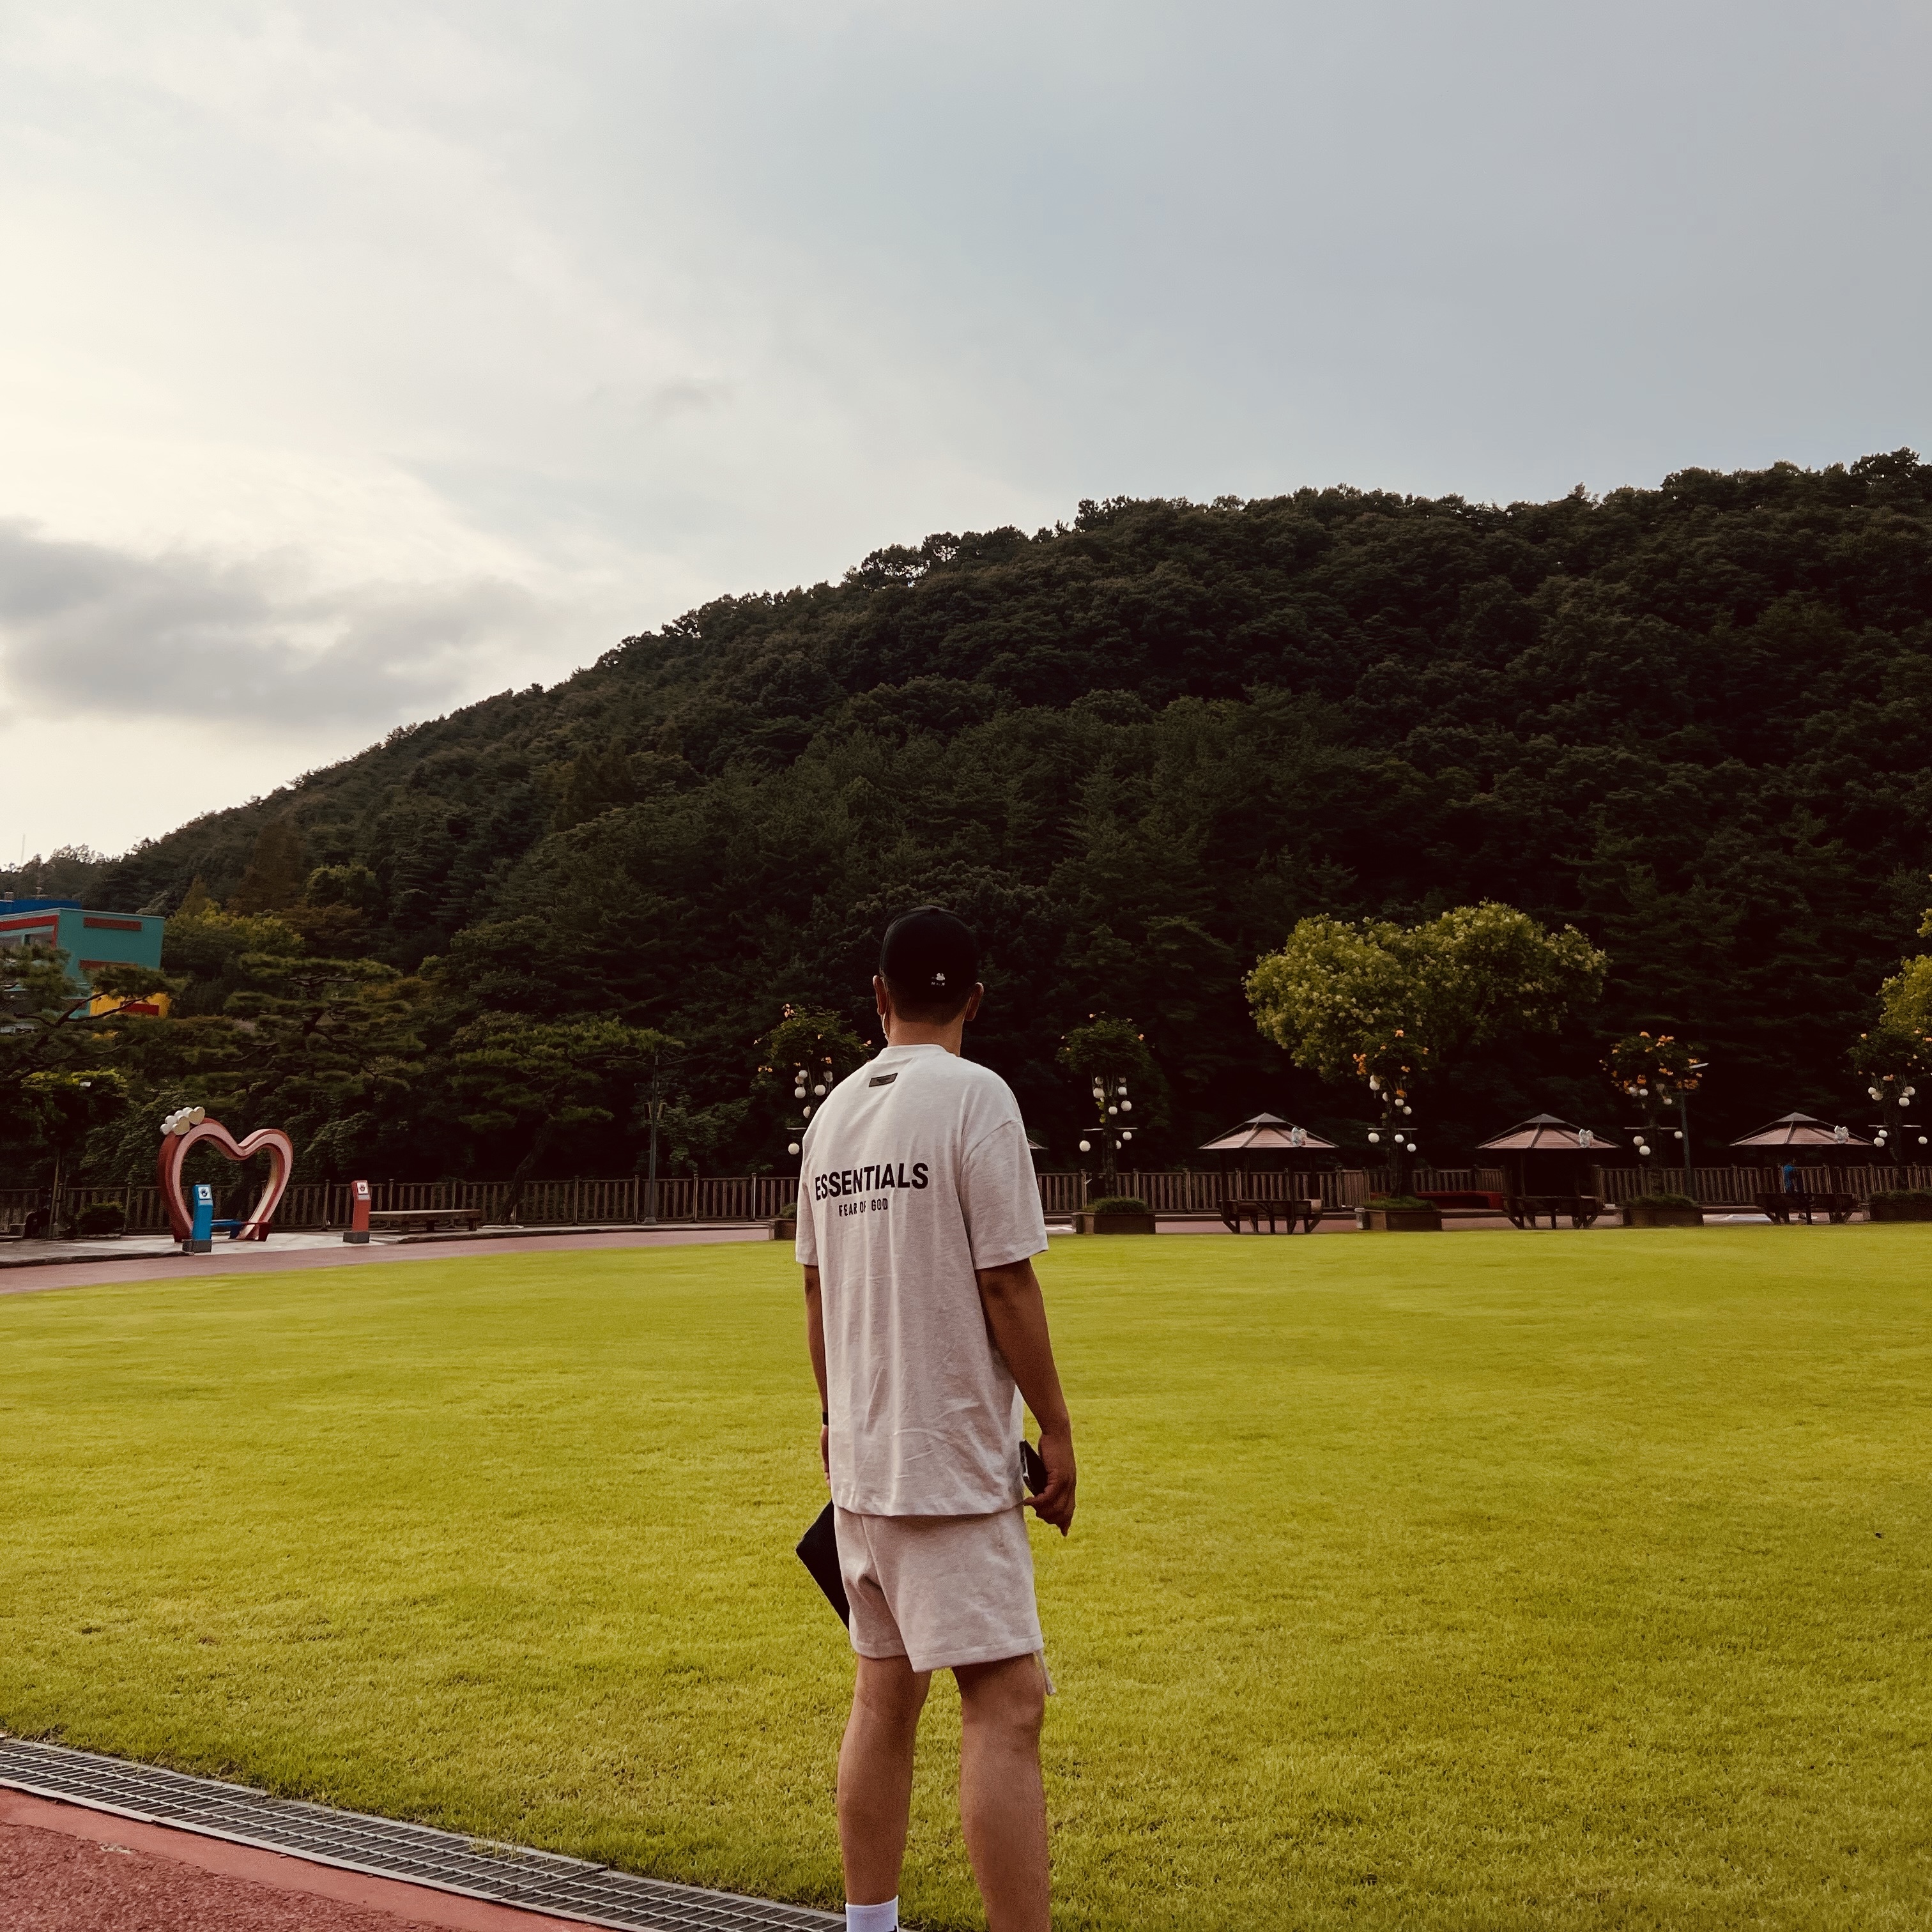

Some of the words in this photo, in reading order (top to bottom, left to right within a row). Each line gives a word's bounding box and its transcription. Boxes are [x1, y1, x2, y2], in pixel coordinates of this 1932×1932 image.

[815, 1163, 929, 1201] ESSENTIALS
[838, 1202, 857, 1217] FEAR
[860, 1201, 866, 1213] OF
[871, 1198, 889, 1212] GOD
